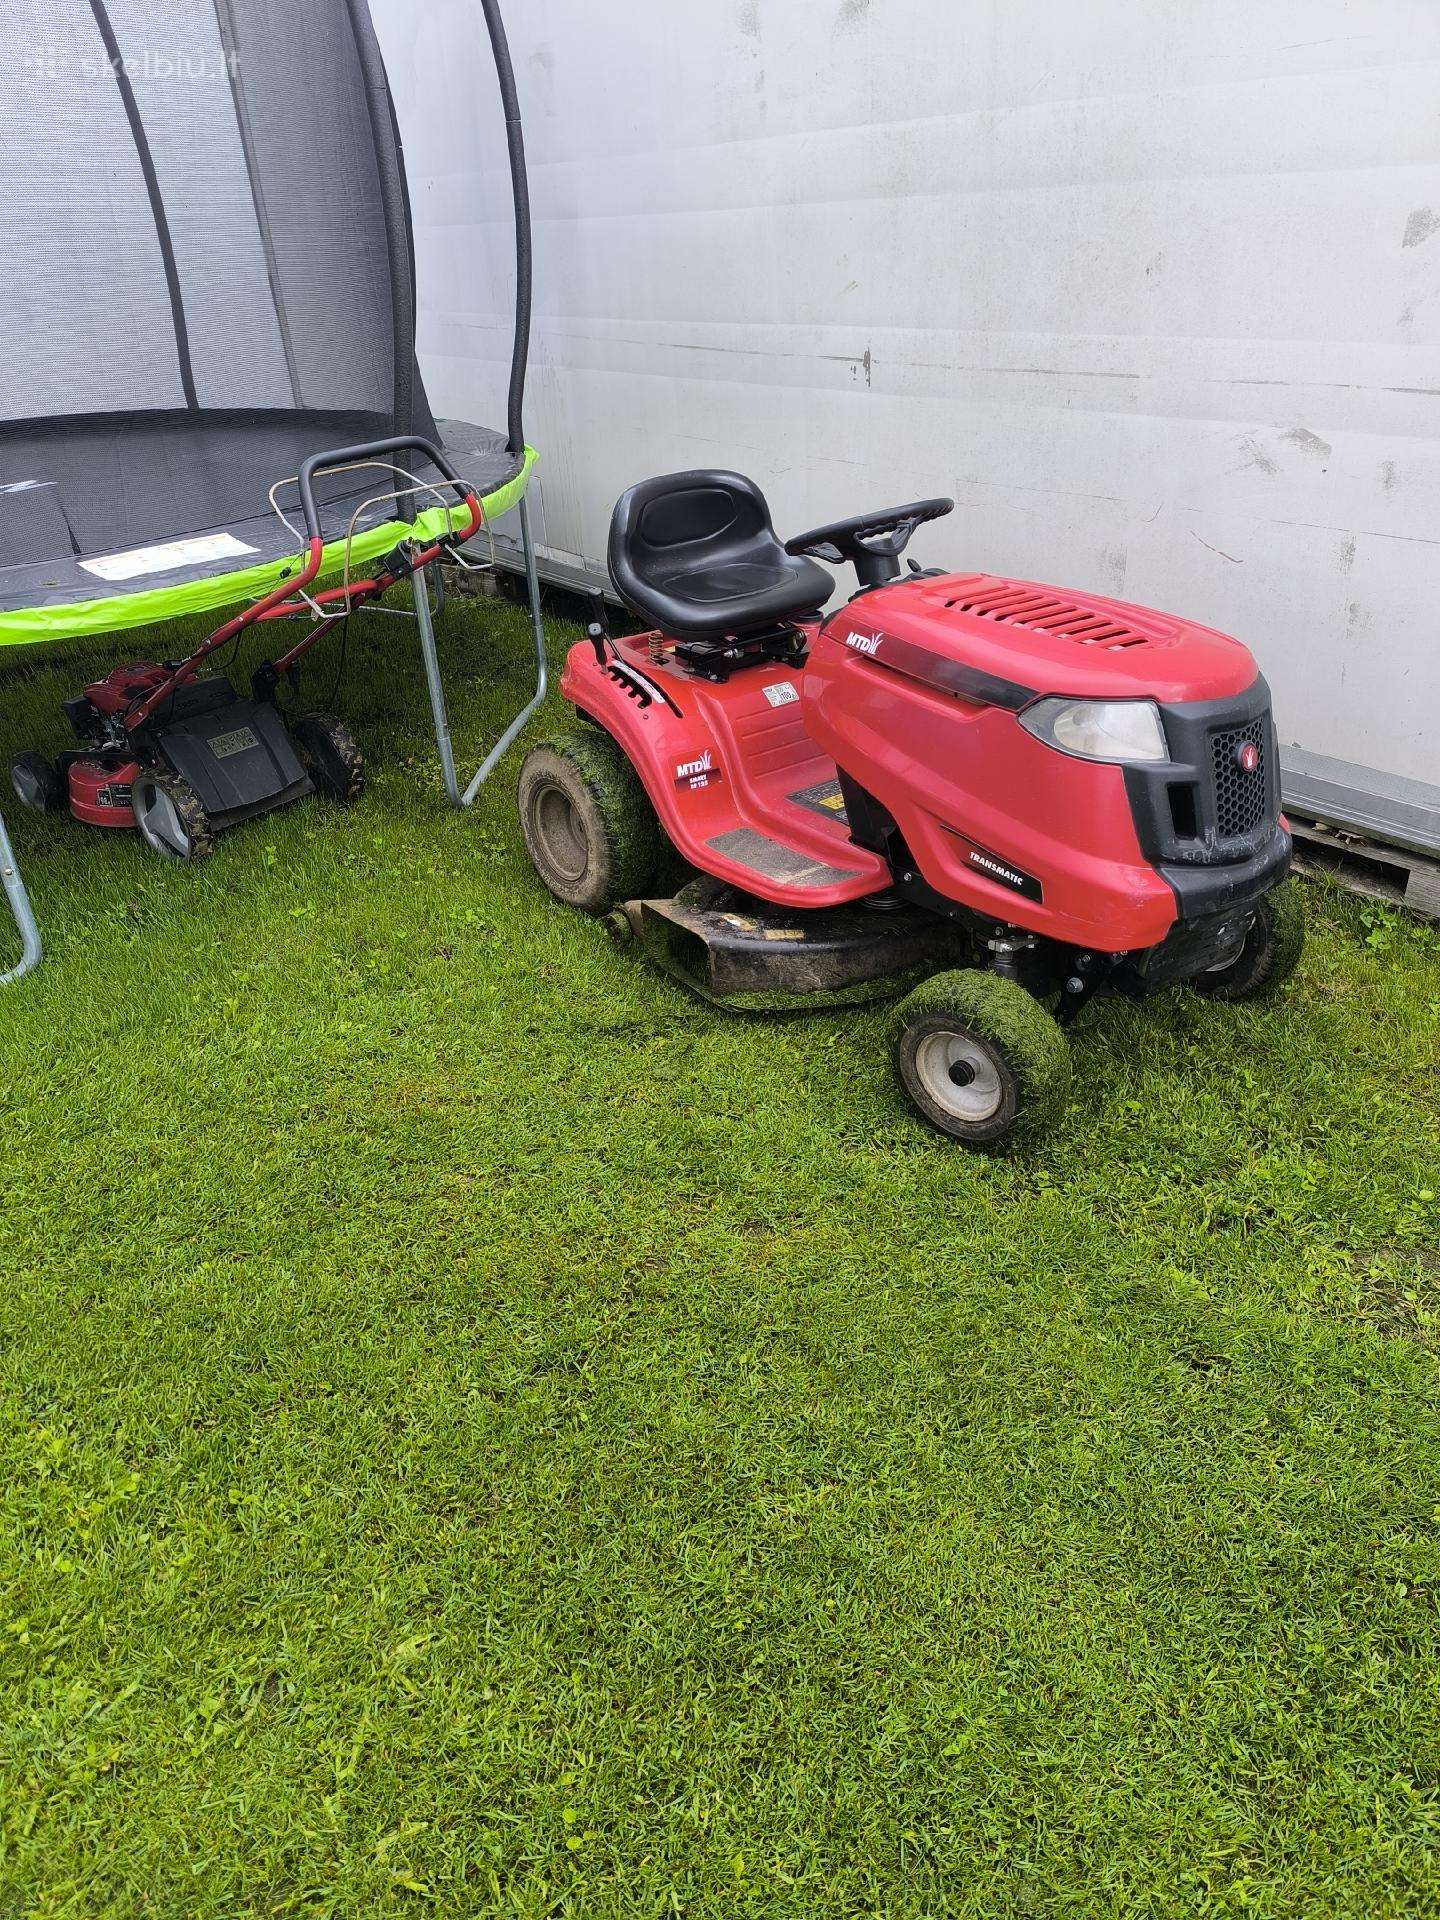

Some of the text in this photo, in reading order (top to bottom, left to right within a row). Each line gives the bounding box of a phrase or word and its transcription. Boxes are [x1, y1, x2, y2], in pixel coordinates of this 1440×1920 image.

[846, 631, 871, 652] MTD
[676, 760, 703, 777] MTD
[969, 851, 1023, 886] TRANSMATIC
